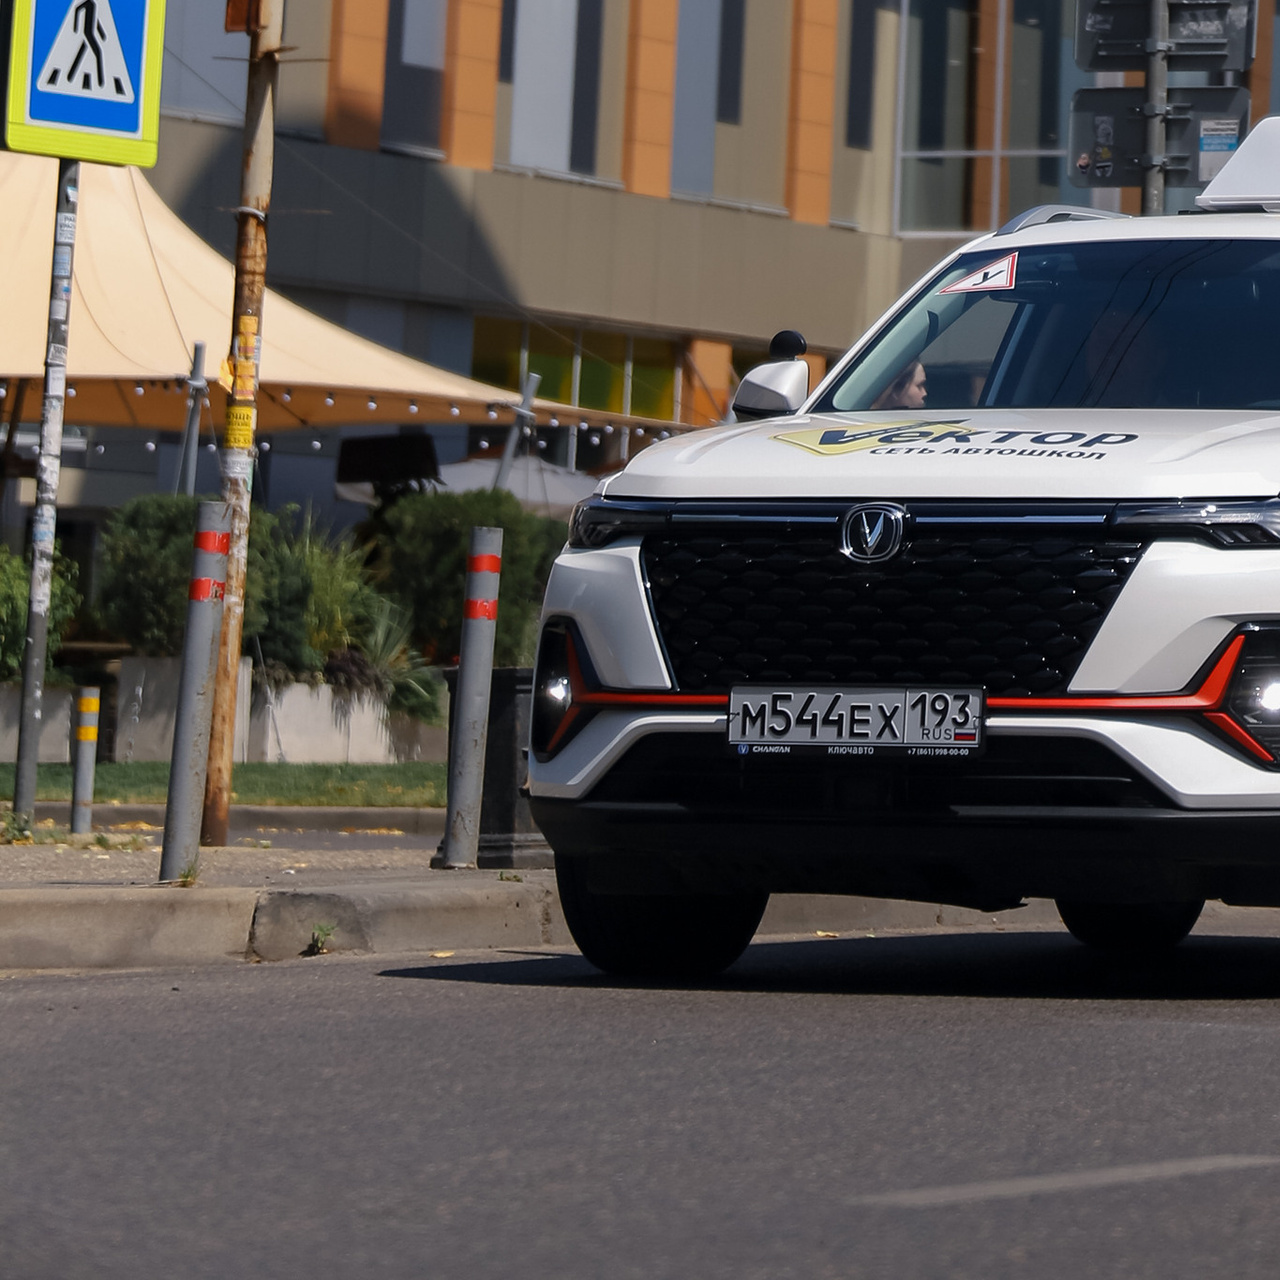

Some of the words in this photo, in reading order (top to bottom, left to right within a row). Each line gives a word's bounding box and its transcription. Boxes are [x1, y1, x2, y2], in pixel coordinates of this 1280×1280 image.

[869, 446, 936, 457] СЕТЬ
[941, 446, 1108, 461] АВТОШКОЛ
[910, 692, 972, 728] 193
[921, 728, 952, 740] RUS
[917, 748, 934, 756] (861)
[935, 748, 969, 756] 998-00-00
